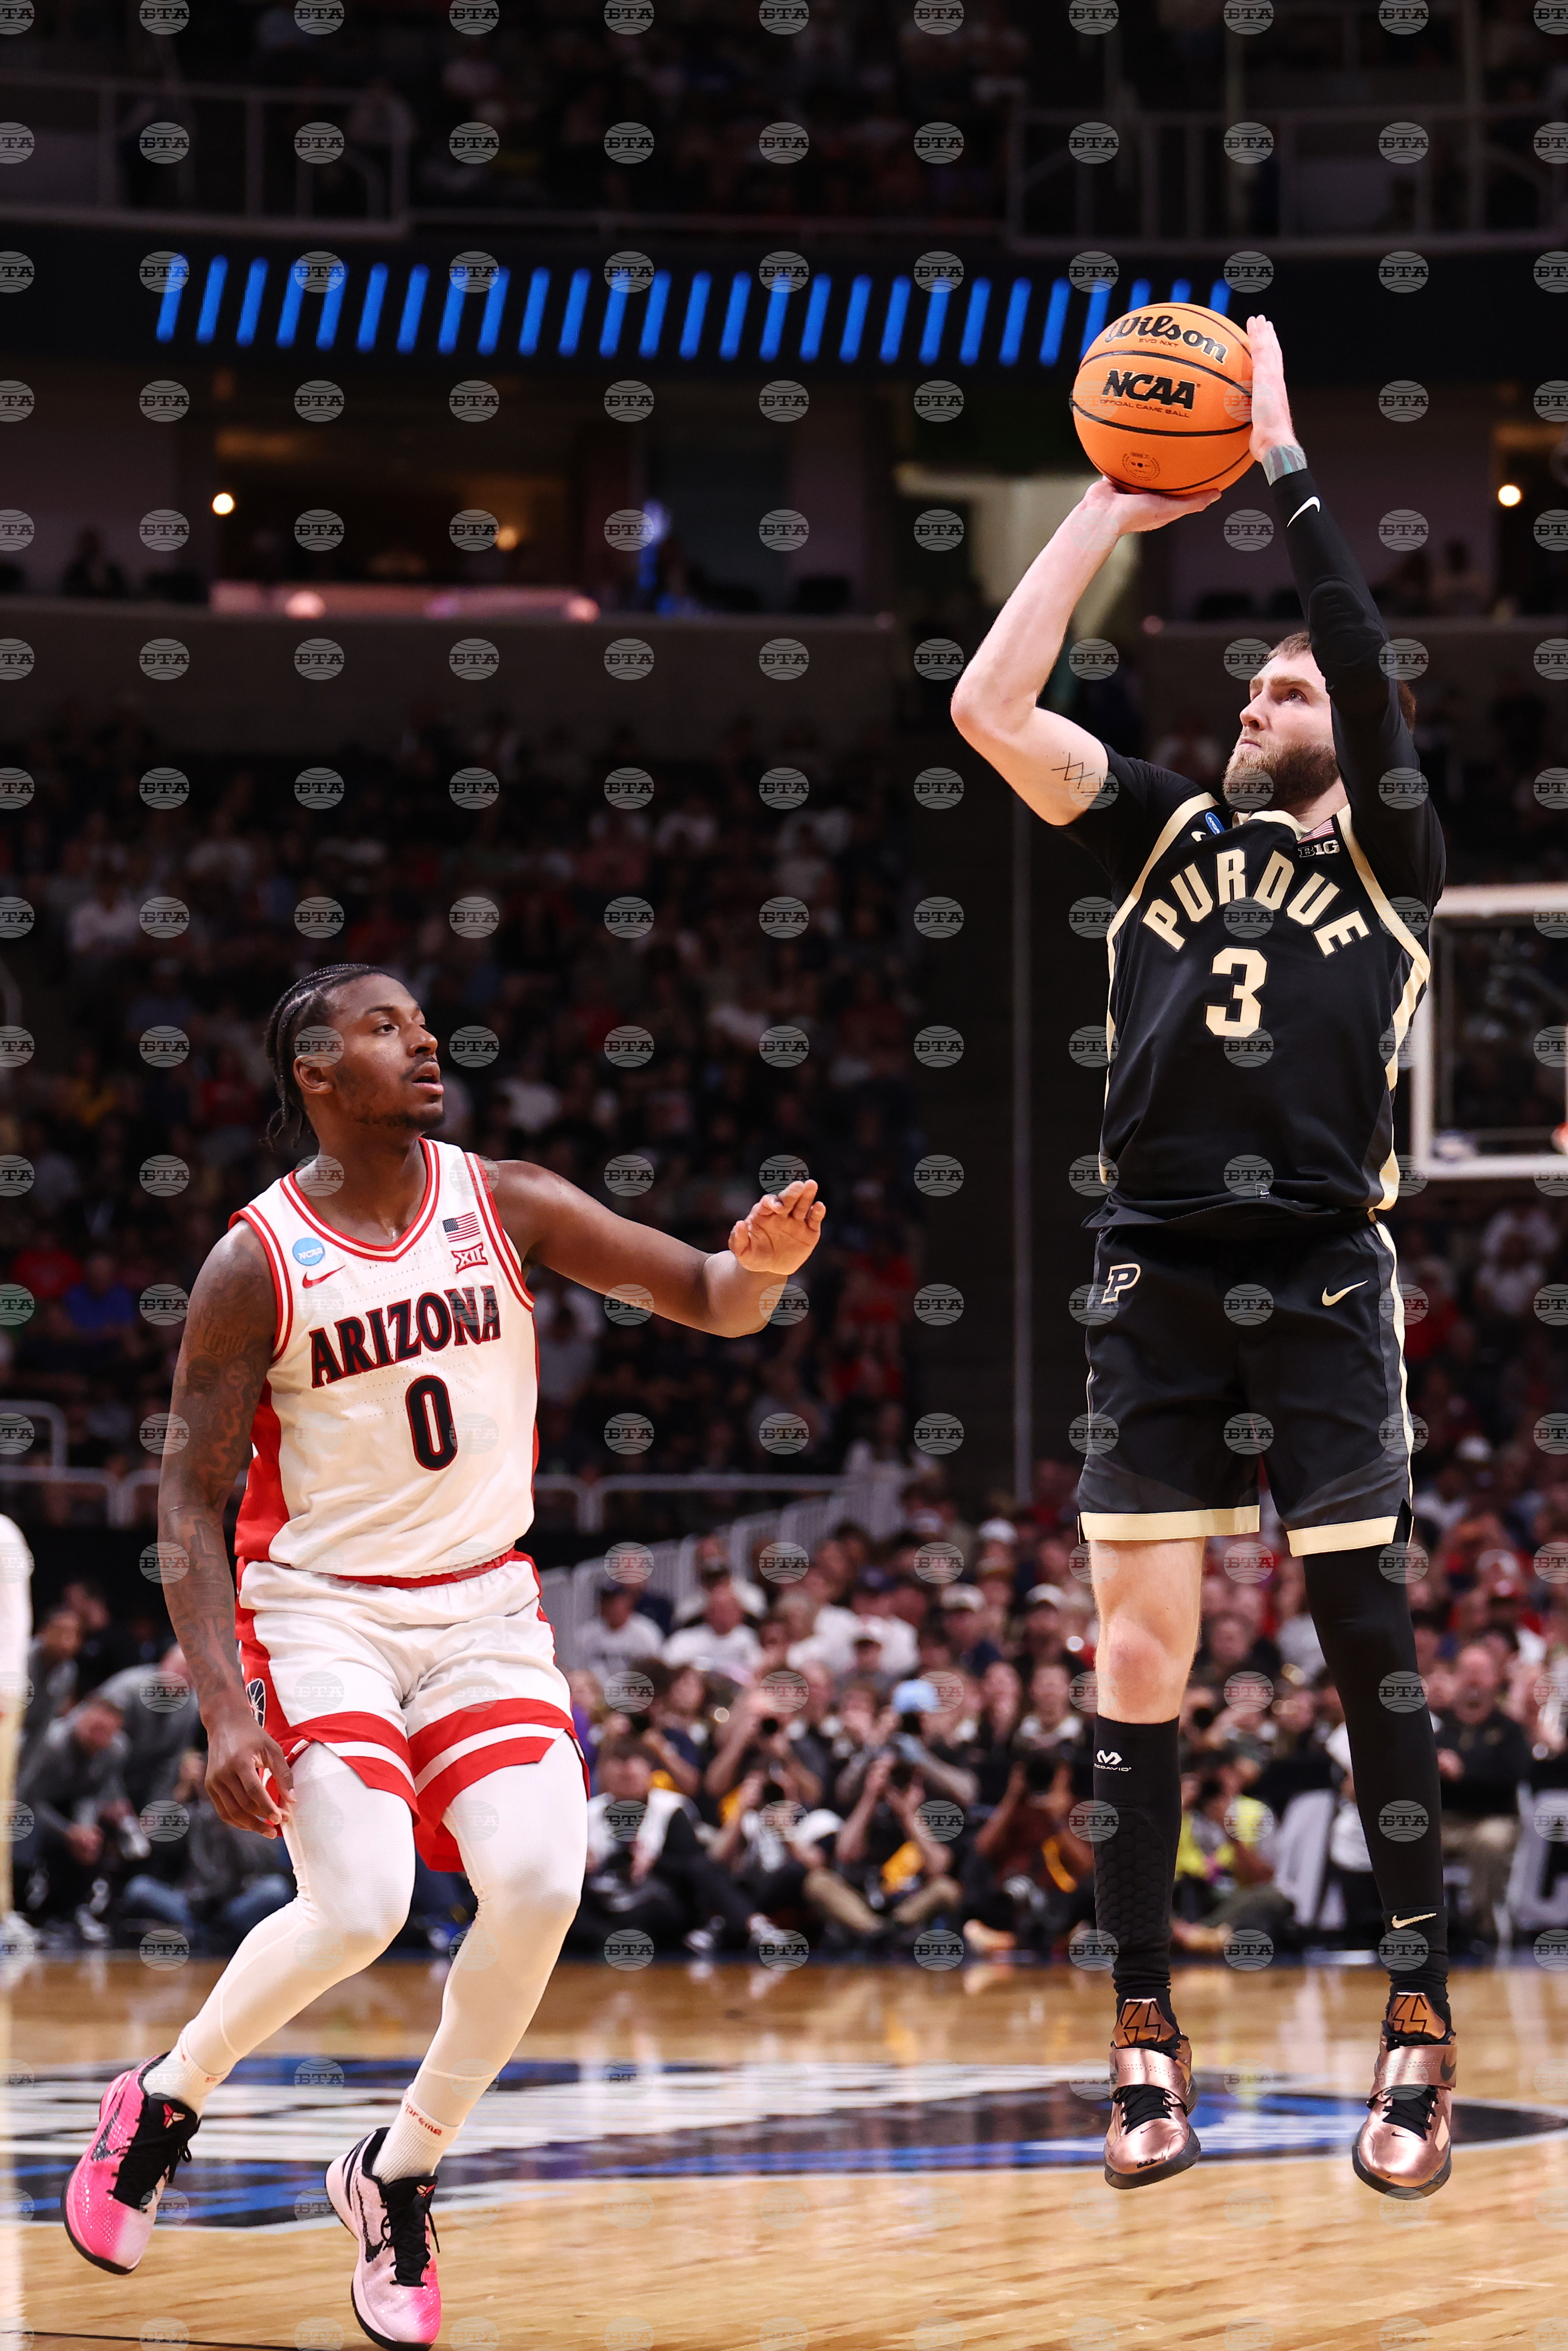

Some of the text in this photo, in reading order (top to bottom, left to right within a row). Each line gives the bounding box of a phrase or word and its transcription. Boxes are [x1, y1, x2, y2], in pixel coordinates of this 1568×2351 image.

[1105, 315, 1228, 364] Wilson
[1100, 399, 1190, 418] OFFICIAL GAME BALL
[1101, 368, 1196, 410] NCAA
[1139, 847, 1372, 958] PURDUE
[1205, 946, 1269, 1038] 3
[297, 1246, 324, 1260] NCAA
[1101, 1263, 1141, 1304] P
[309, 1285, 501, 1388] ARIZONA
[405, 1375, 458, 1471] 0
